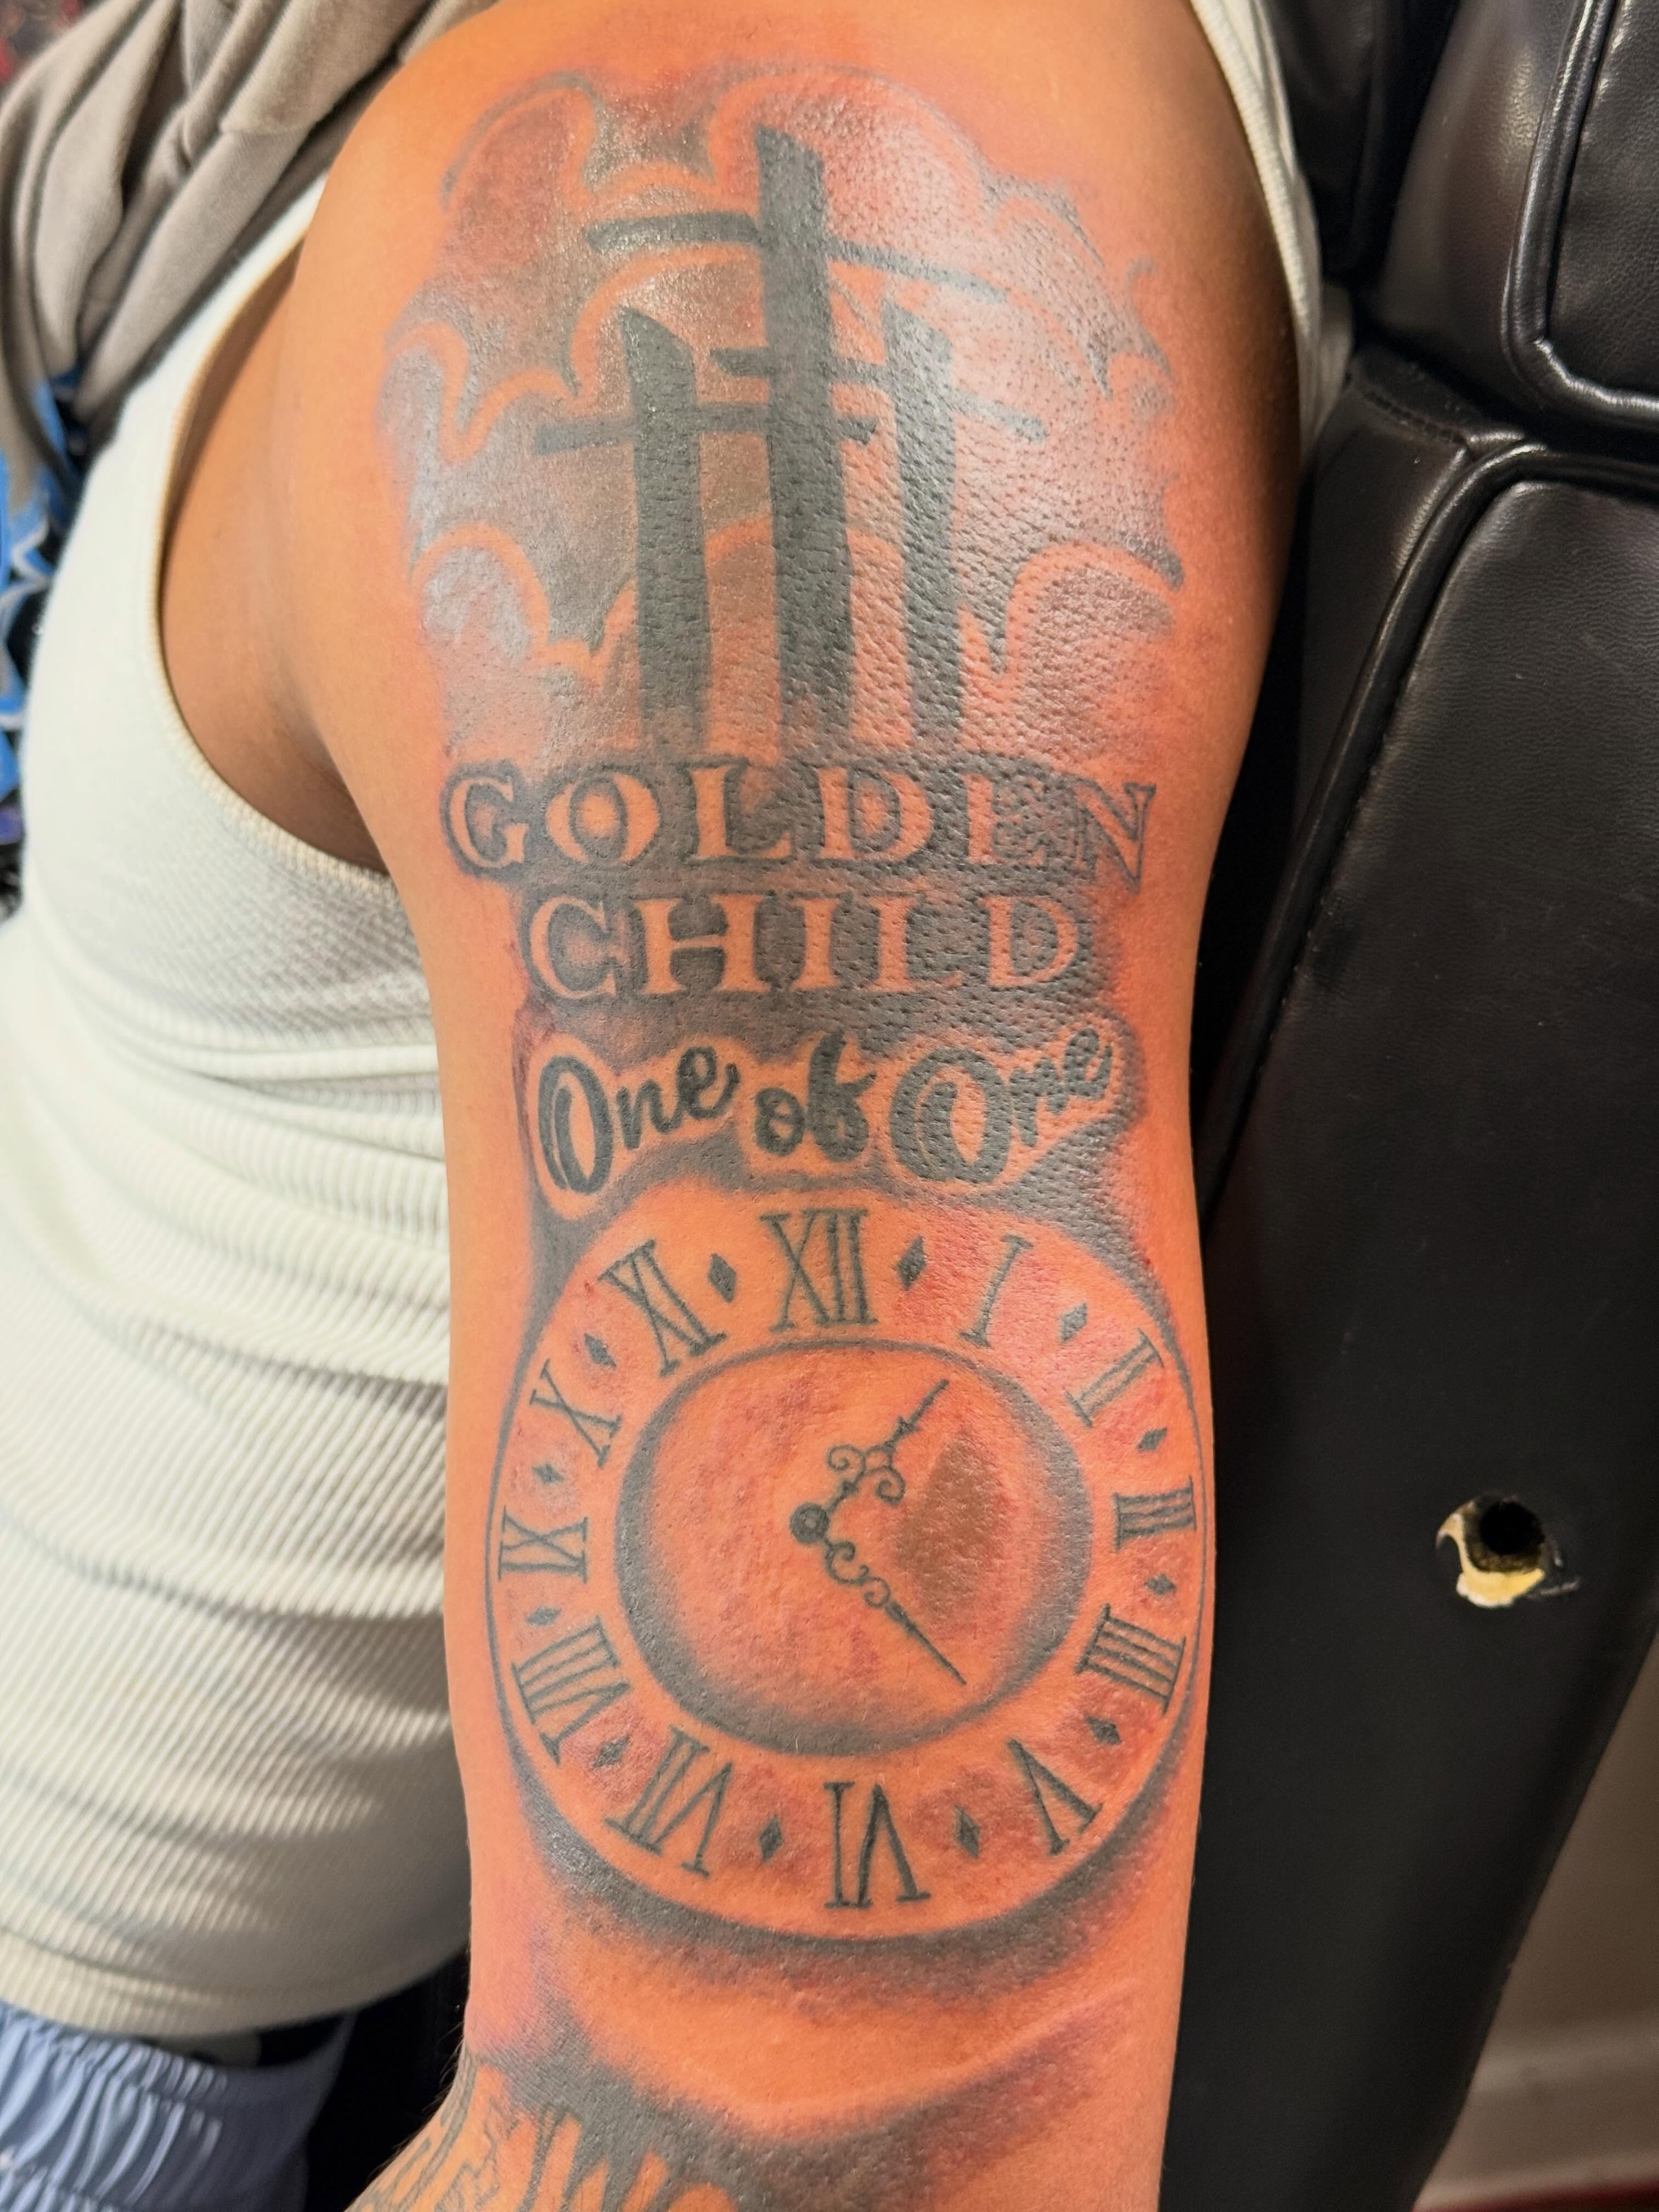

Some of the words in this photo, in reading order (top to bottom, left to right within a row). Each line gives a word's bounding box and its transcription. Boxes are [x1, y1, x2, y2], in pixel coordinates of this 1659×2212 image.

[444, 759, 1156, 891] GOLDEN
[522, 890, 1080, 1000] CHILD
[538, 1046, 741, 1195] One
[890, 1028, 1113, 1184] One
[597, 1239, 727, 1378] XI
[759, 1208, 879, 1332] XII
[958, 1234, 1034, 1347] I
[530, 1358, 622, 1468] X
[1064, 1327, 1164, 1427] II
[498, 1506, 589, 1584] IX
[1112, 1475, 1197, 1554] III
[511, 1615, 630, 1765] VIII
[1075, 1602, 1186, 1716] IIII
[605, 1725, 732, 1878] VII
[824, 1782, 931, 1909] VI
[1008, 1739, 1103, 1855] V
